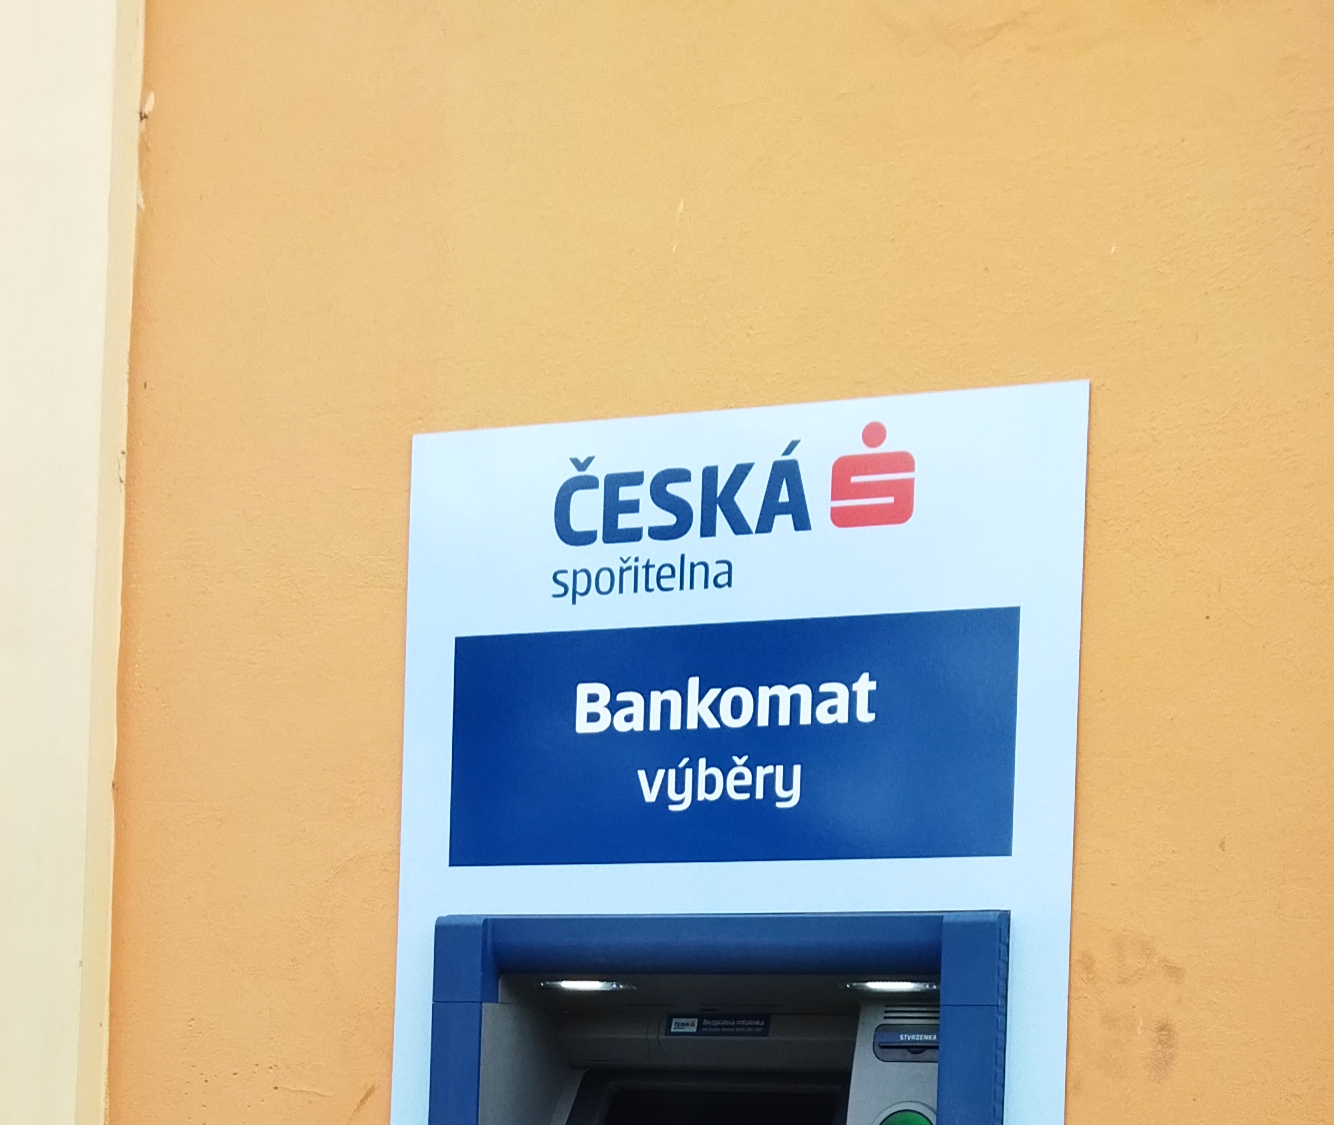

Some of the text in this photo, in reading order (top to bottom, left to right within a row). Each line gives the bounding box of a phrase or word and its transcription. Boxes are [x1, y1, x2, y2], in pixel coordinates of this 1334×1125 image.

[553, 439, 812, 547] ČESKÁ
[551, 553, 734, 604] spořitelna
[575, 672, 877, 734] Bankomat
[637, 755, 802, 811] výběry
